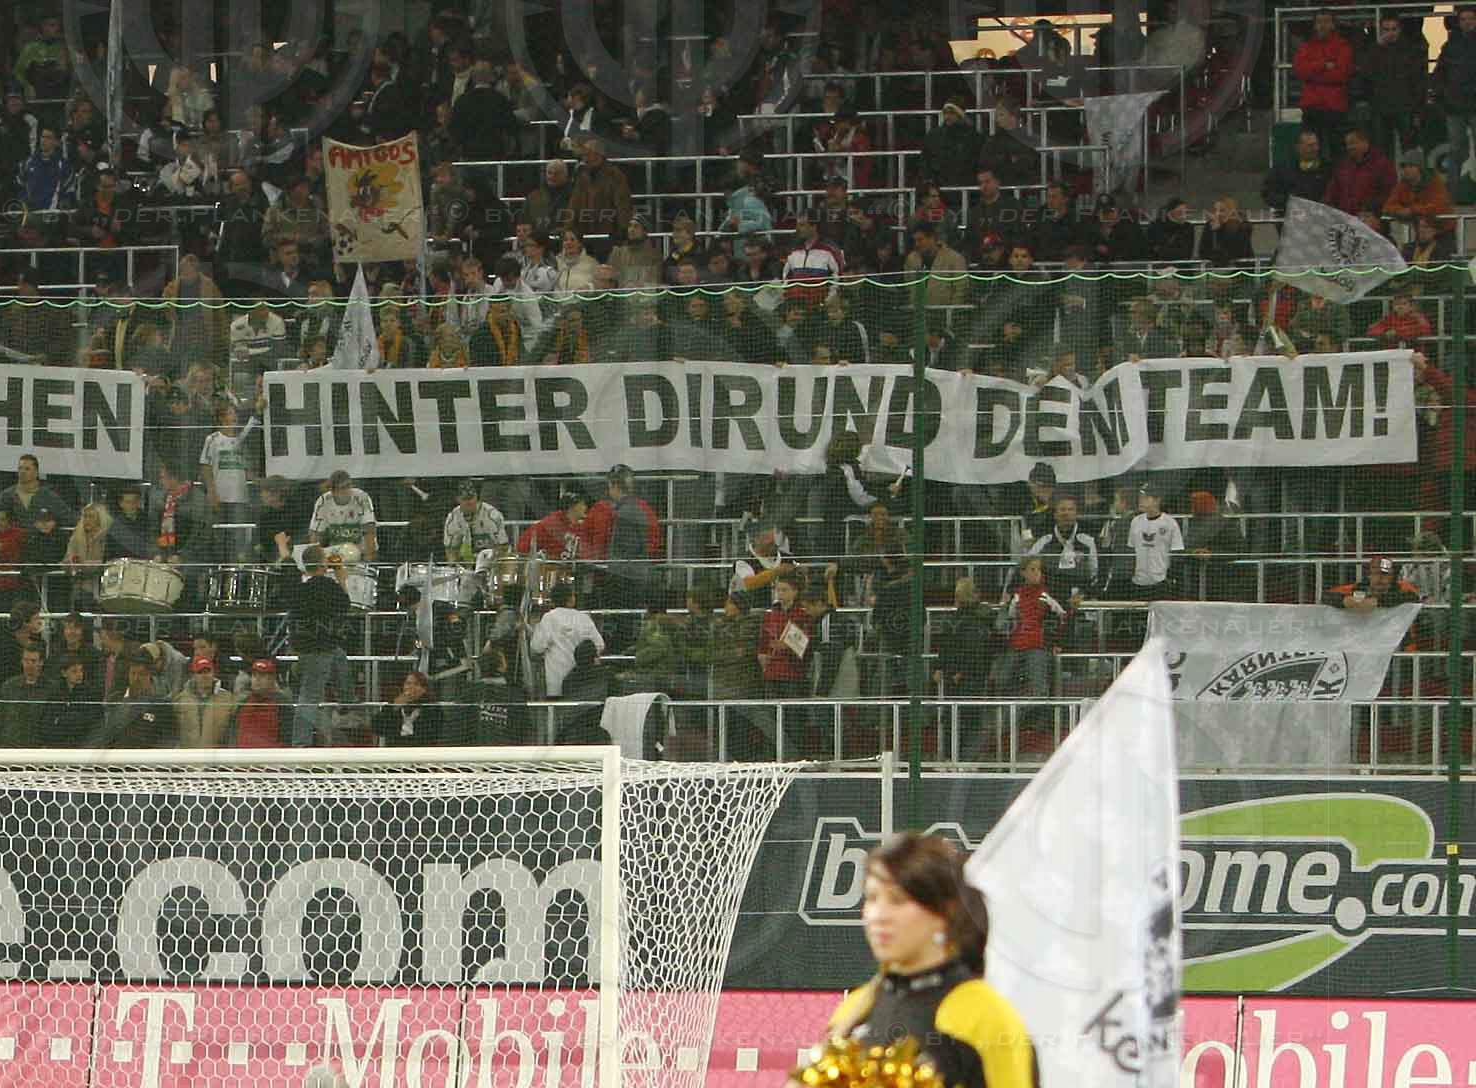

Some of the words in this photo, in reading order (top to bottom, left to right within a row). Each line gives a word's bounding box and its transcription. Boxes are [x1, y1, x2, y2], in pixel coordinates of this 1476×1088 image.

[268, 376, 597, 457] HINTER
[973, 376, 1130, 458] DEN
[1140, 361, 1390, 443] TEAM!
